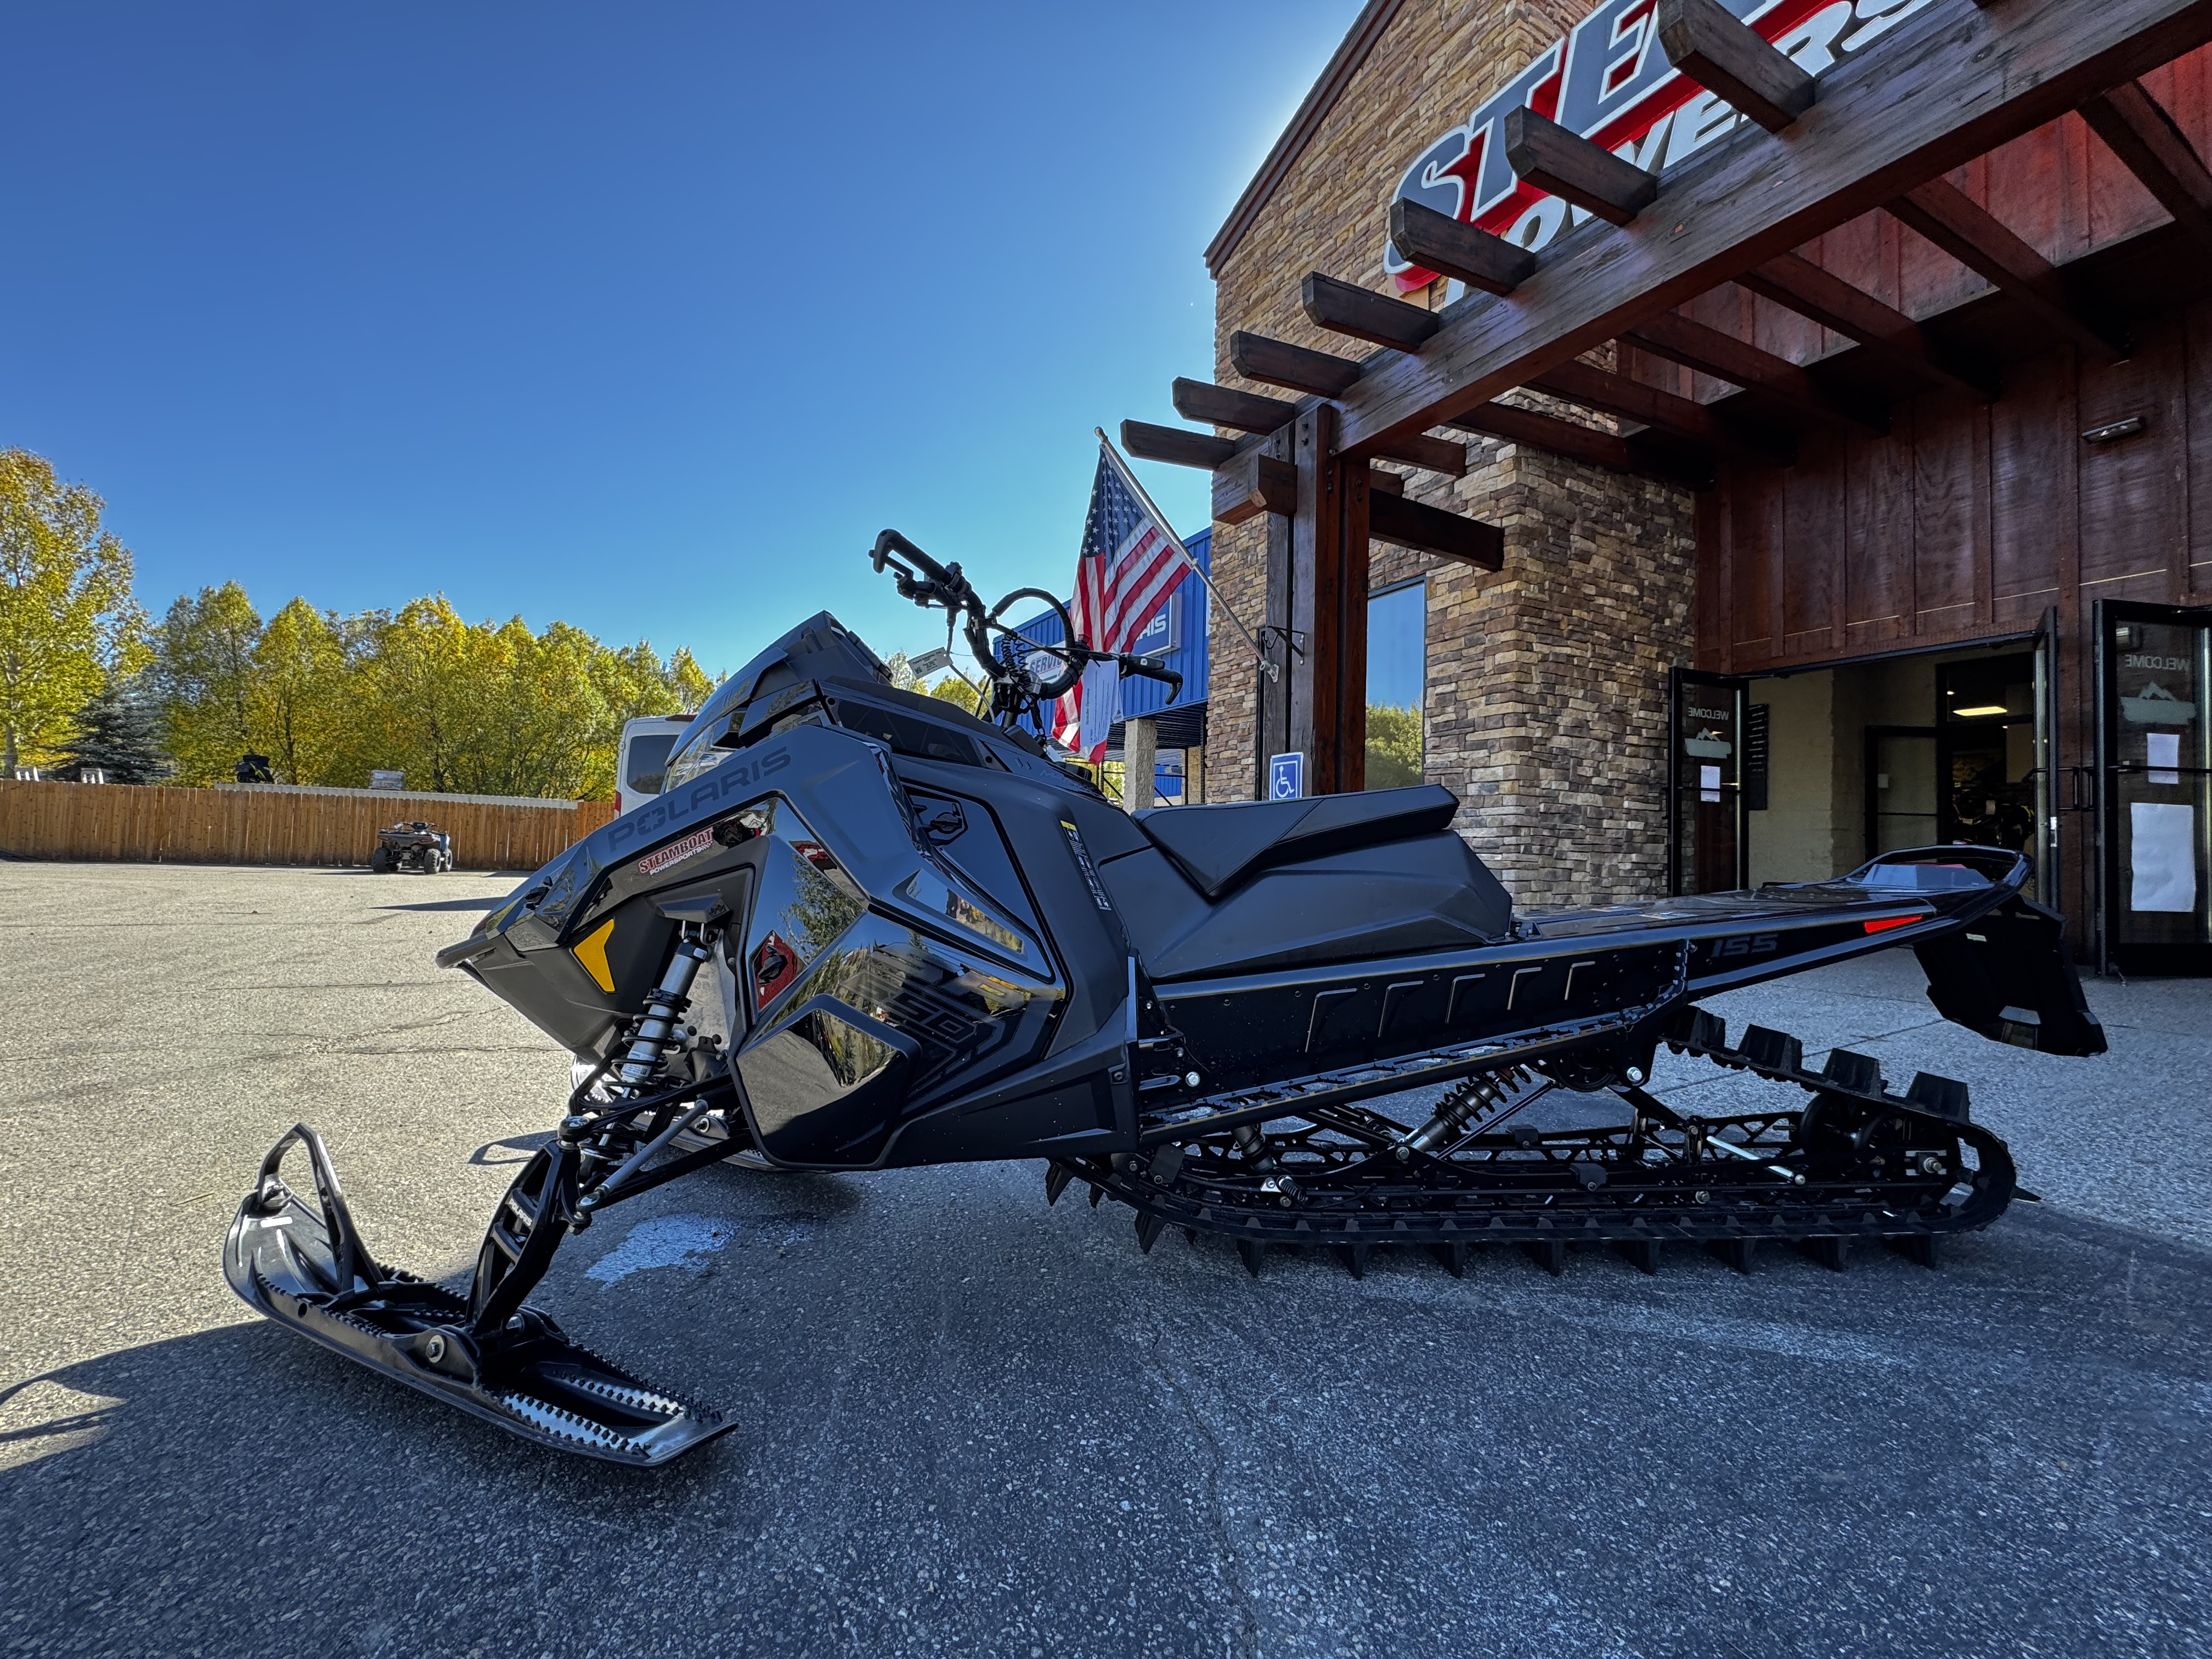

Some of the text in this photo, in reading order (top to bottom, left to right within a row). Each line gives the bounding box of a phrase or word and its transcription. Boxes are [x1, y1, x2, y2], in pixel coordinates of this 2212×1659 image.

[608, 746, 791, 854] POLARIS
[638, 827, 714, 874] STEAMBOAT
[650, 845, 702, 875] POWERSPORTS
[1711, 933, 1779, 958] 155
[509, 1198, 533, 1226] POLARIS
